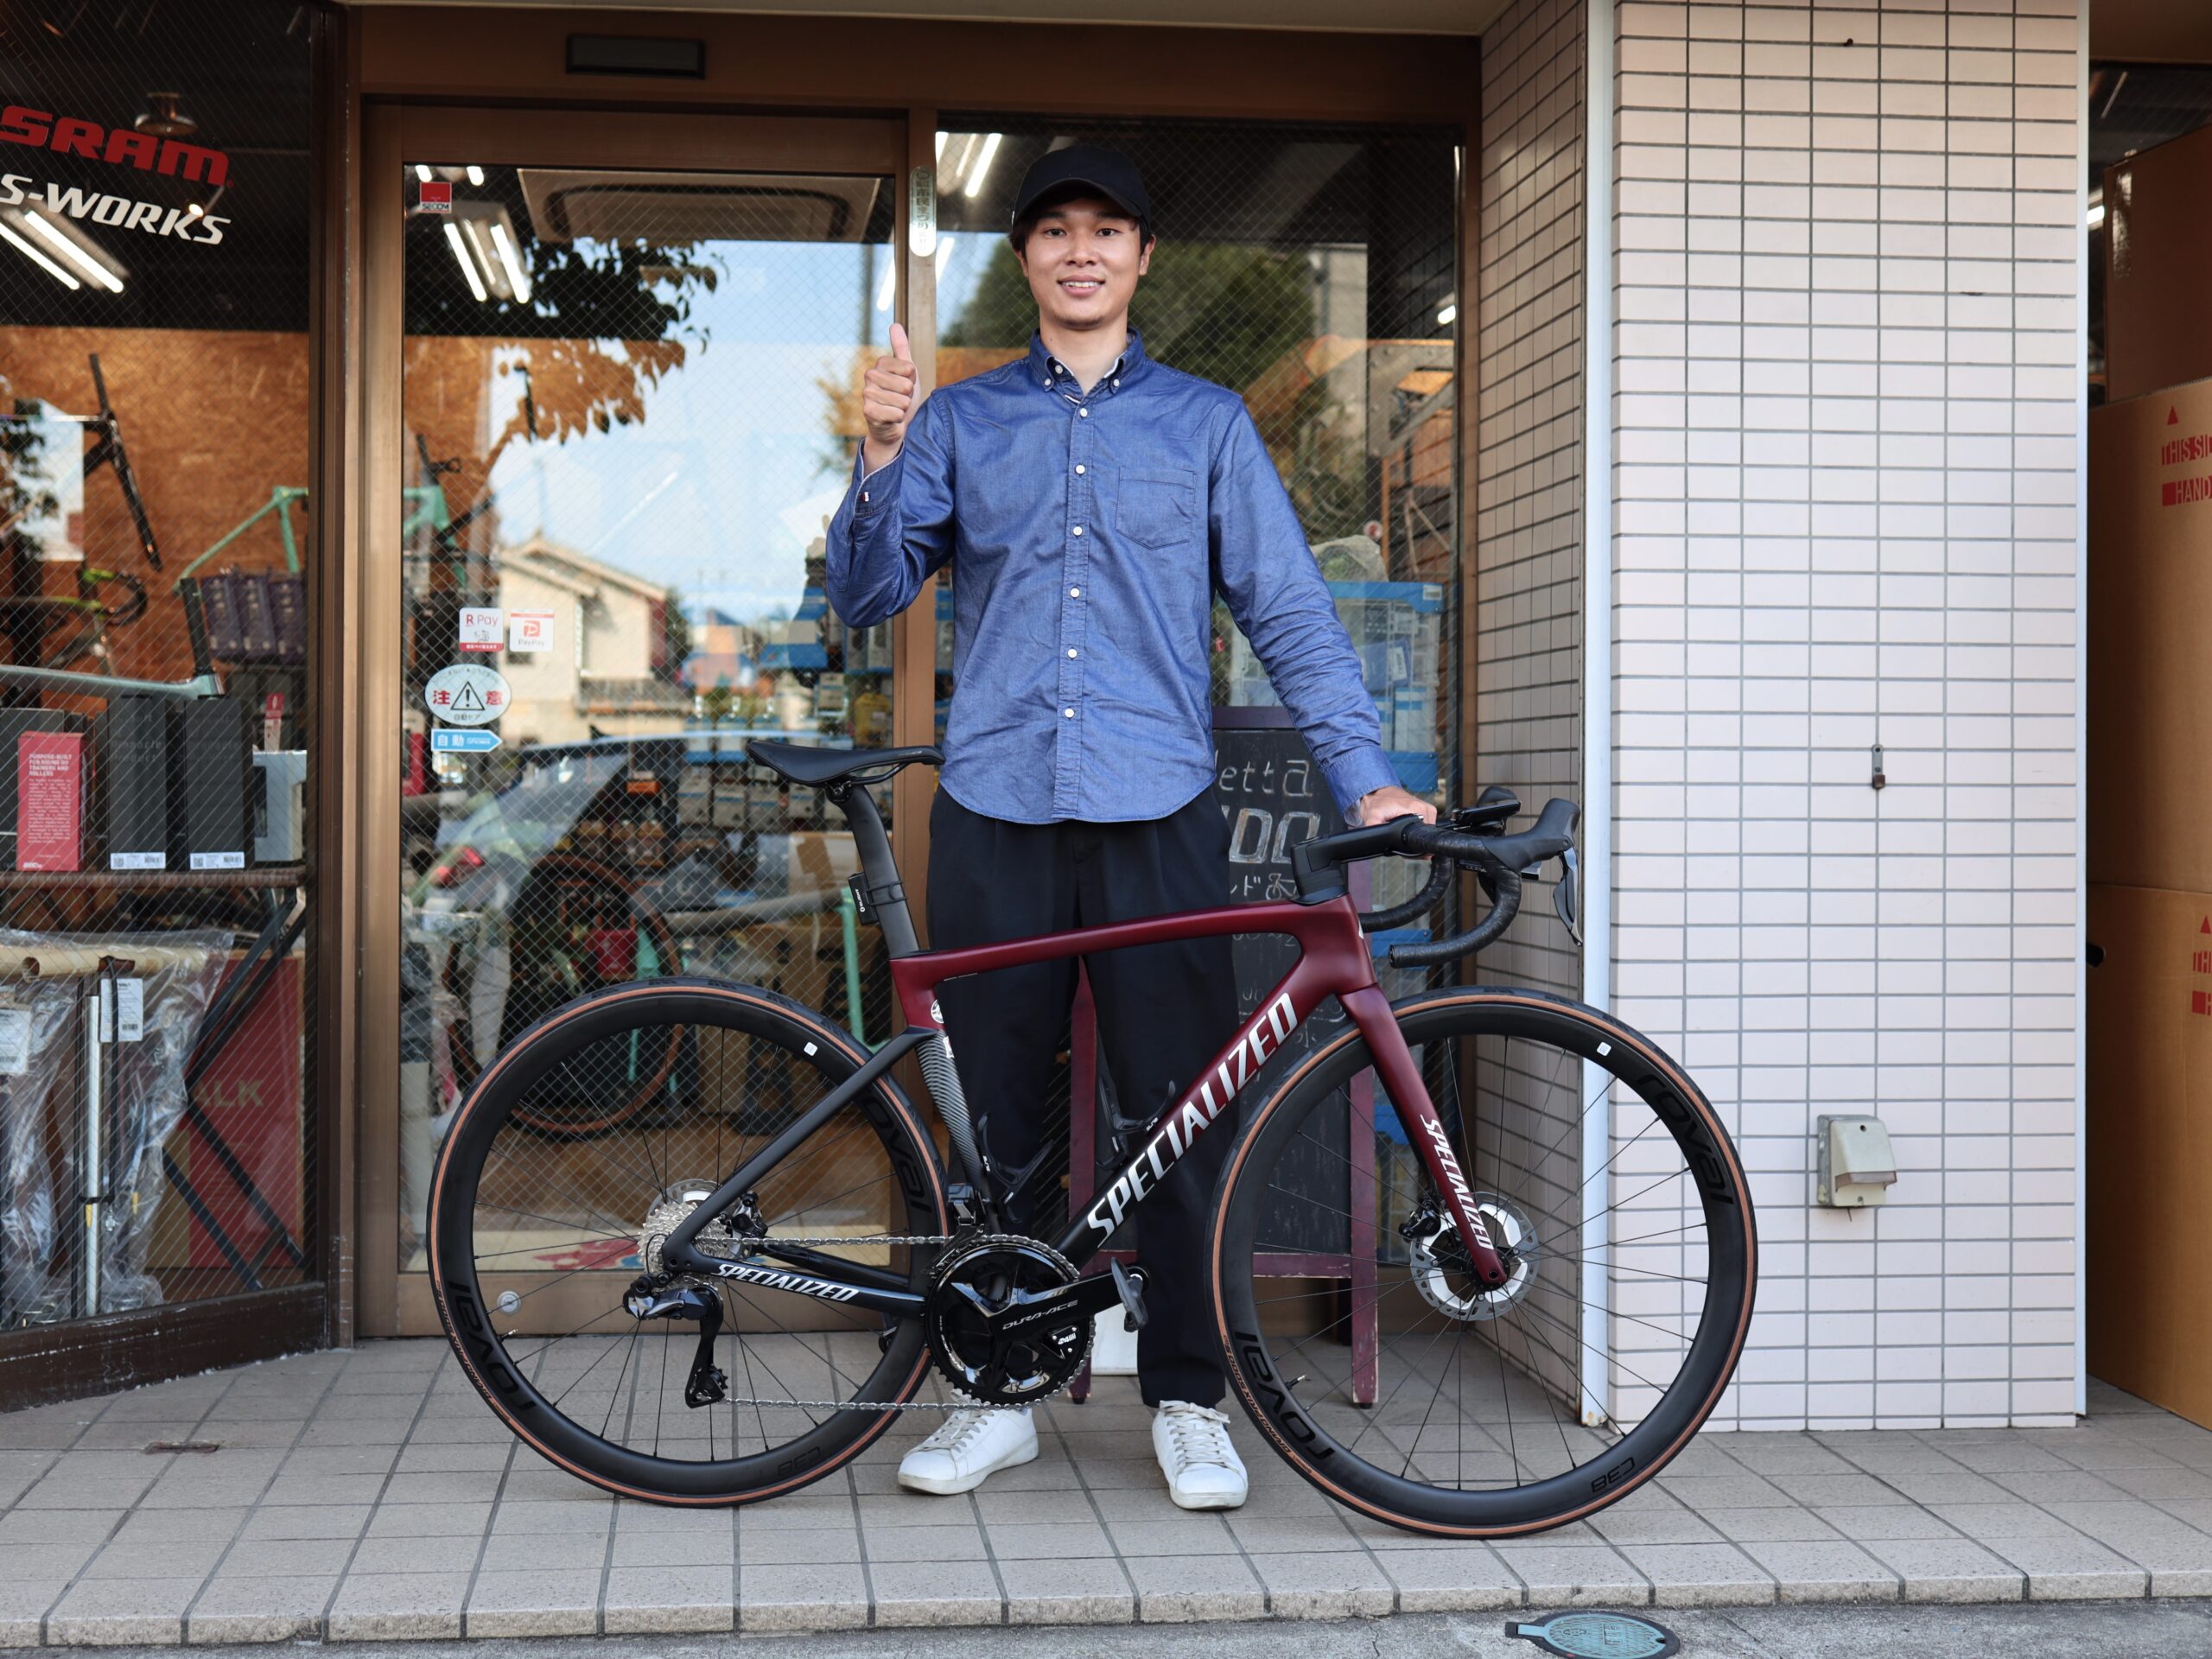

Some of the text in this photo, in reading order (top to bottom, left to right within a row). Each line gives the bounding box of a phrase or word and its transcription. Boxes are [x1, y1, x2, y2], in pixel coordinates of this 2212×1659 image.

[0, 105, 230, 187] SRAM
[0, 174, 232, 245] S-WORKS
[2163, 438, 2191, 467] THIS
[478, 614, 499, 626] Pay
[437, 734, 465, 747] 自動
[1088, 992, 1298, 1248] SPECIALIZED
[1420, 1114, 1494, 1250] SPECIALIZED
[710, 1263, 859, 1302] SPECIALIZED
[1002, 1300, 1078, 1330] DURA-ACE
[1226, 1354, 1246, 1389] 5000
[1243, 1389, 1262, 1419] PRIX
[1261, 1418, 1291, 1453] GRAND
[1591, 1457, 1635, 1493] C38
